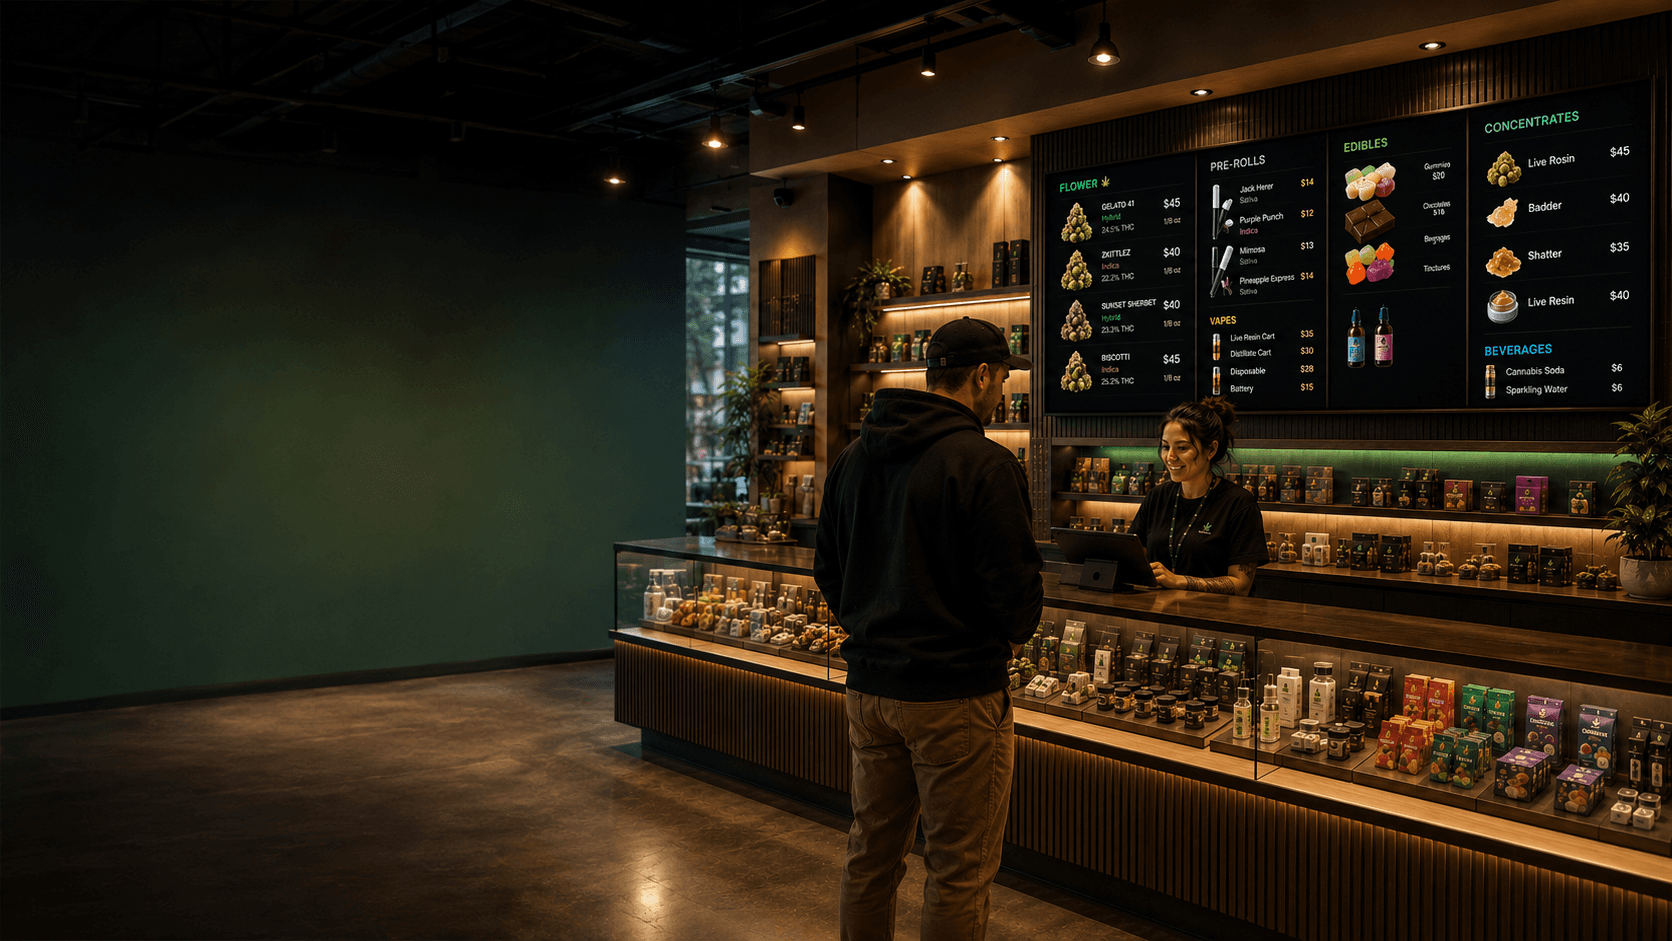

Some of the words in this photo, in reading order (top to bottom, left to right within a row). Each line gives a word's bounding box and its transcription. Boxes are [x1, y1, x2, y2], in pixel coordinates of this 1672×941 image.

[1485, 111, 1579, 133] CONCENTRATES
[1344, 138, 1388, 152] EDIBLES
[1610, 146, 1630, 157] $45
[1211, 155, 1265, 171] PRE-ROLLS
[1528, 158, 1547, 168] Live
[1550, 154, 1575, 165] Rosin
[1060, 179, 1097, 192] FLOWER
[1301, 178, 1314, 187] $14
[1240, 185, 1255, 193] Jack
[1256, 183, 1274, 191] Herer
[1164, 198, 1180, 209] $45
[1610, 193, 1629, 204] $40
[1102, 201, 1126, 210] GELATO
[1529, 201, 1562, 212] Badder
[1240, 215, 1261, 225] Purple
[1263, 212, 1283, 221] Punch
[1301, 209, 1314, 218] $12
[1121, 223, 1134, 231] THC
[1301, 241, 1314, 250] $13
[1610, 242, 1629, 253] $35
[1164, 247, 1180, 258] $40
[1528, 250, 1562, 260] Shatter
[1424, 264, 1450, 272] Tinctures
[1240, 276, 1270, 287] Pineapple
[1271, 274, 1295, 284] Express
[1301, 272, 1313, 280] $14
[1610, 290, 1629, 301] $40
[1102, 301, 1126, 309] SUNSET
[1163, 300, 1180, 310] $40
[1528, 298, 1546, 307] Live
[1549, 296, 1574, 305] Resin
[1210, 316, 1236, 325] VAPES
[1301, 330, 1314, 338] $35
[1485, 344, 1552, 356] BEVERAGES
[1102, 353, 1130, 361] BISCOTTI
[1163, 354, 1180, 364] $45
[1300, 365, 1314, 373] $28
[1506, 367, 1542, 376] Cannabis
[1544, 366, 1564, 374] Soda
[1612, 363, 1622, 372] $6
[1231, 385, 1253, 393] Battery
[1301, 383, 1314, 391] $15
[1506, 386, 1542, 396] Sparkling
[1544, 385, 1568, 393] Water
[1612, 383, 1622, 392] $6
